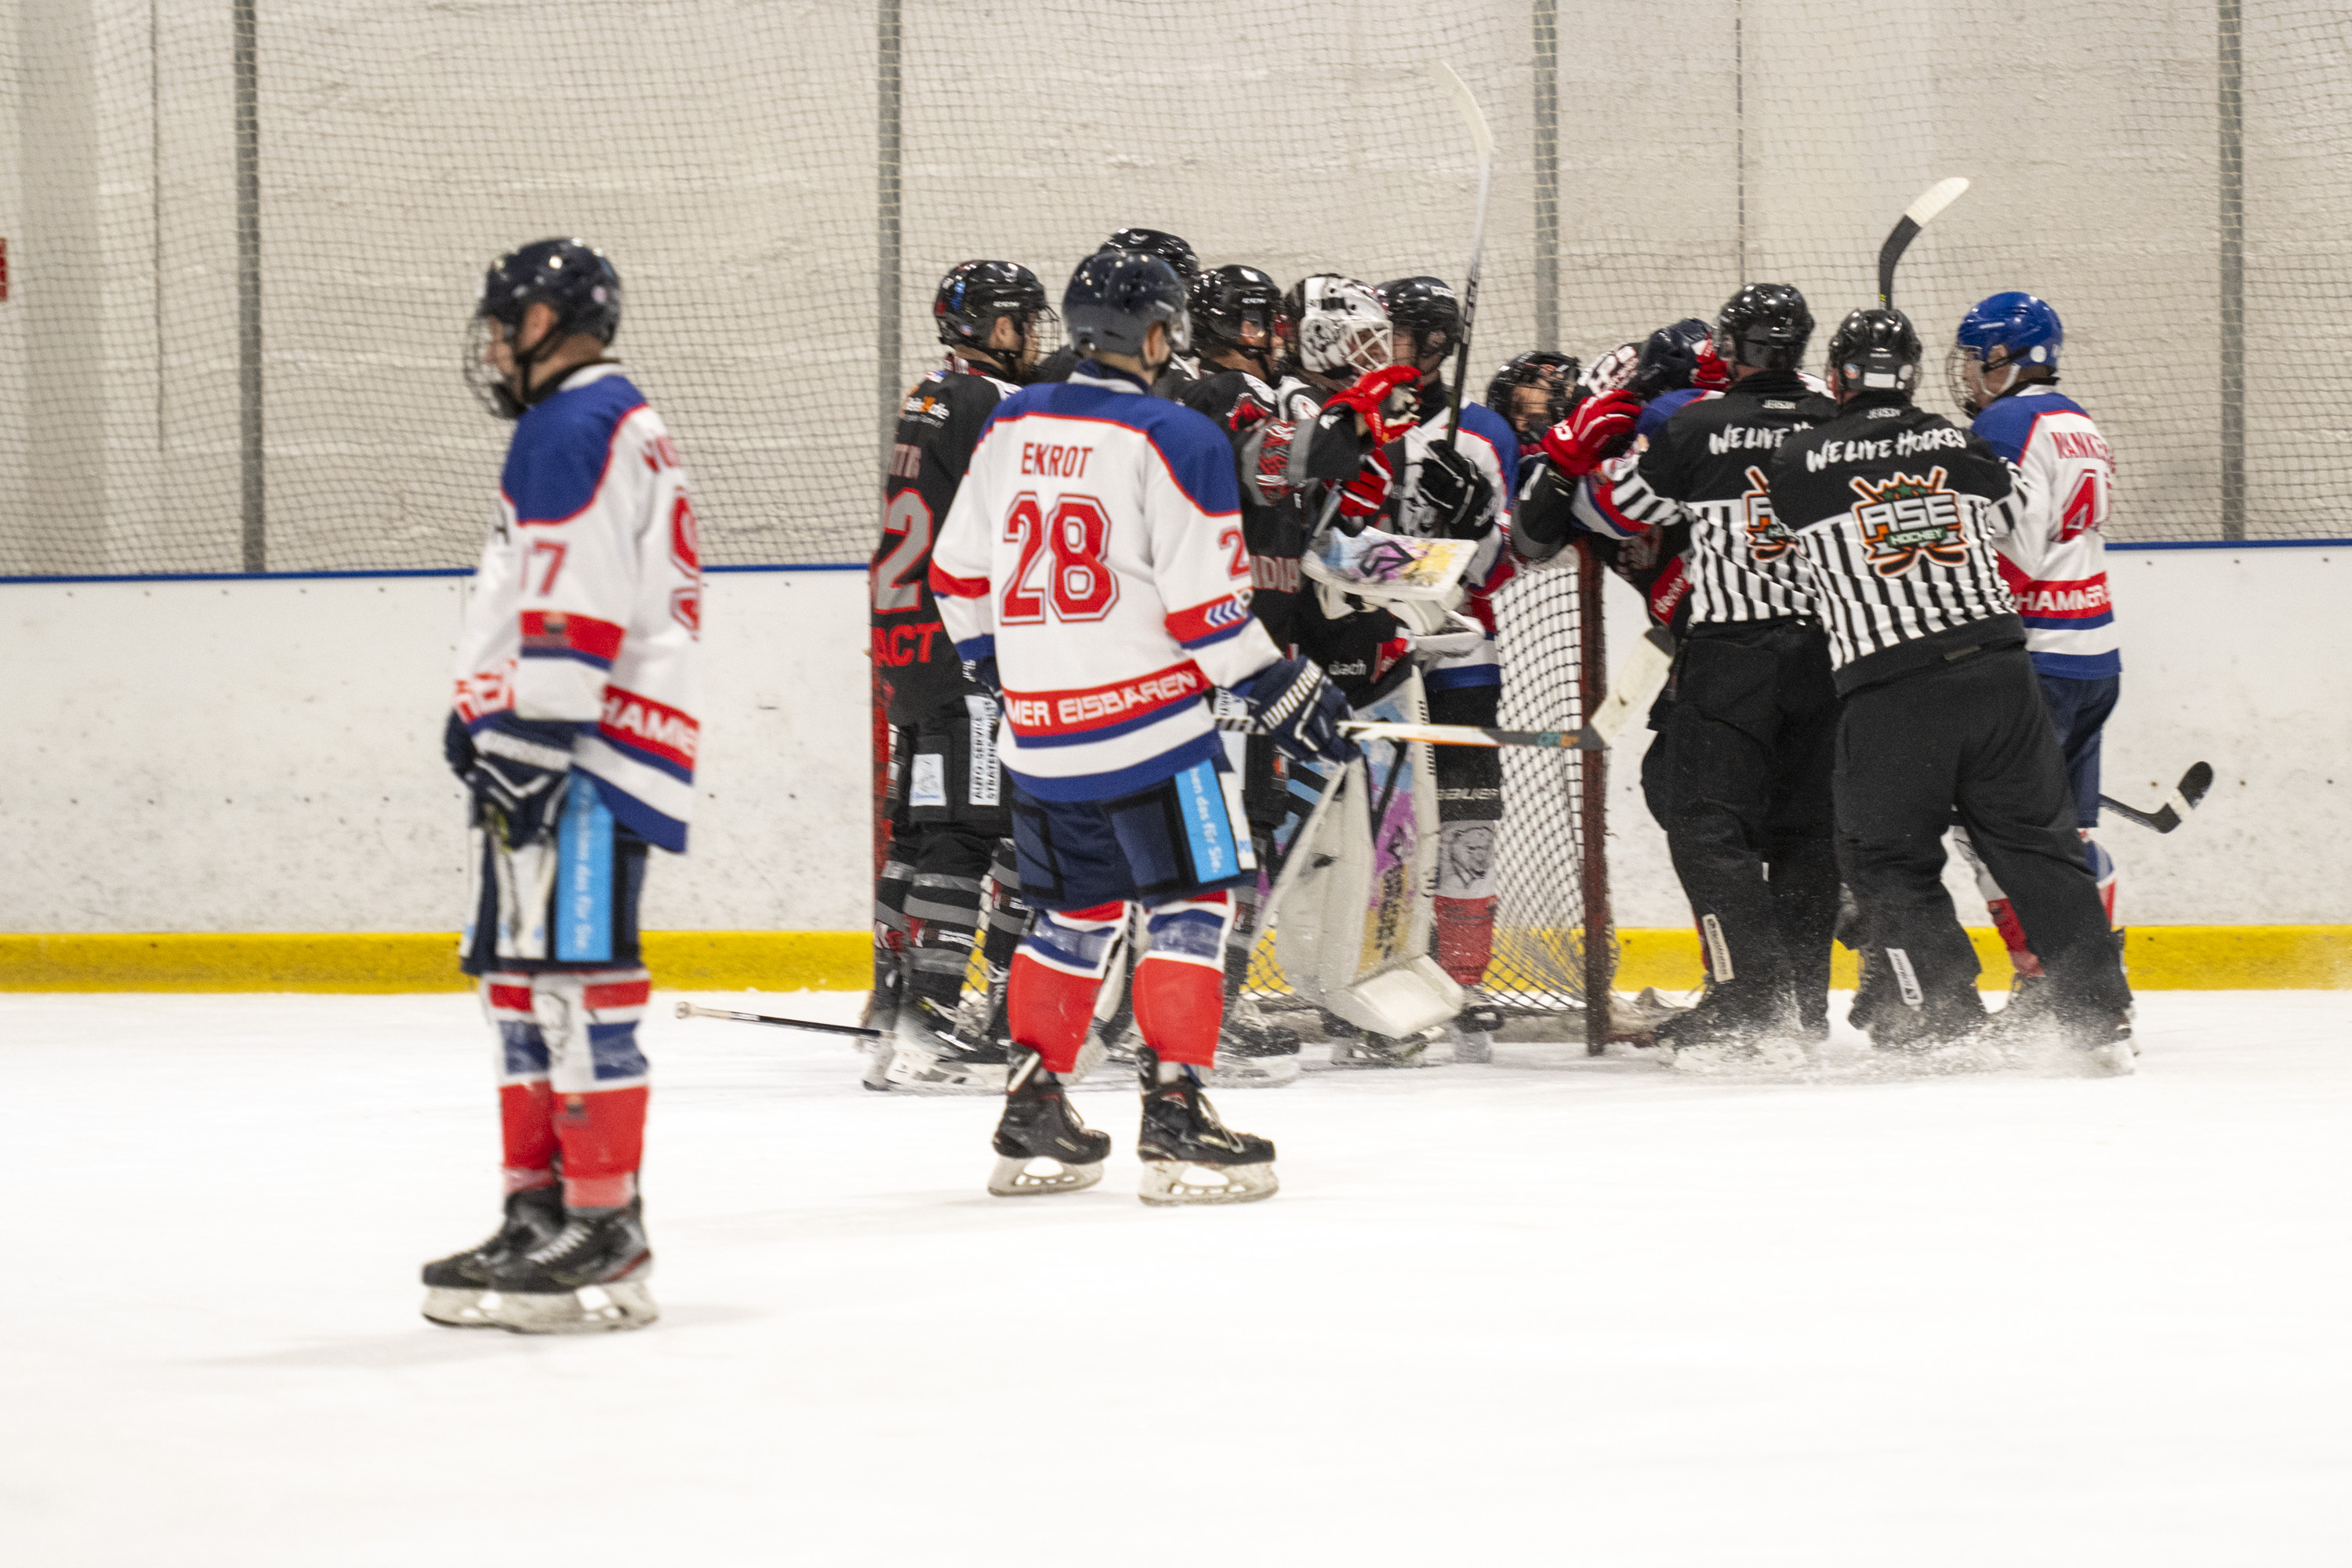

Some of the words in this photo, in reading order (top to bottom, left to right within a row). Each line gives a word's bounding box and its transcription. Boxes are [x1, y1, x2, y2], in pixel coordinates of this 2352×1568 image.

[1021, 441, 1094, 479] EKROT
[1709, 423, 1744, 455] WE
[1806, 439, 1844, 473] WE
[1843, 439, 1893, 463] LIVE
[1895, 427, 1968, 458] HOCKEY
[1860, 495, 1960, 538] ASE
[1889, 528, 1944, 546] HOCKEY
[872, 487, 934, 615] 2
[1000, 489, 1120, 627] 28
